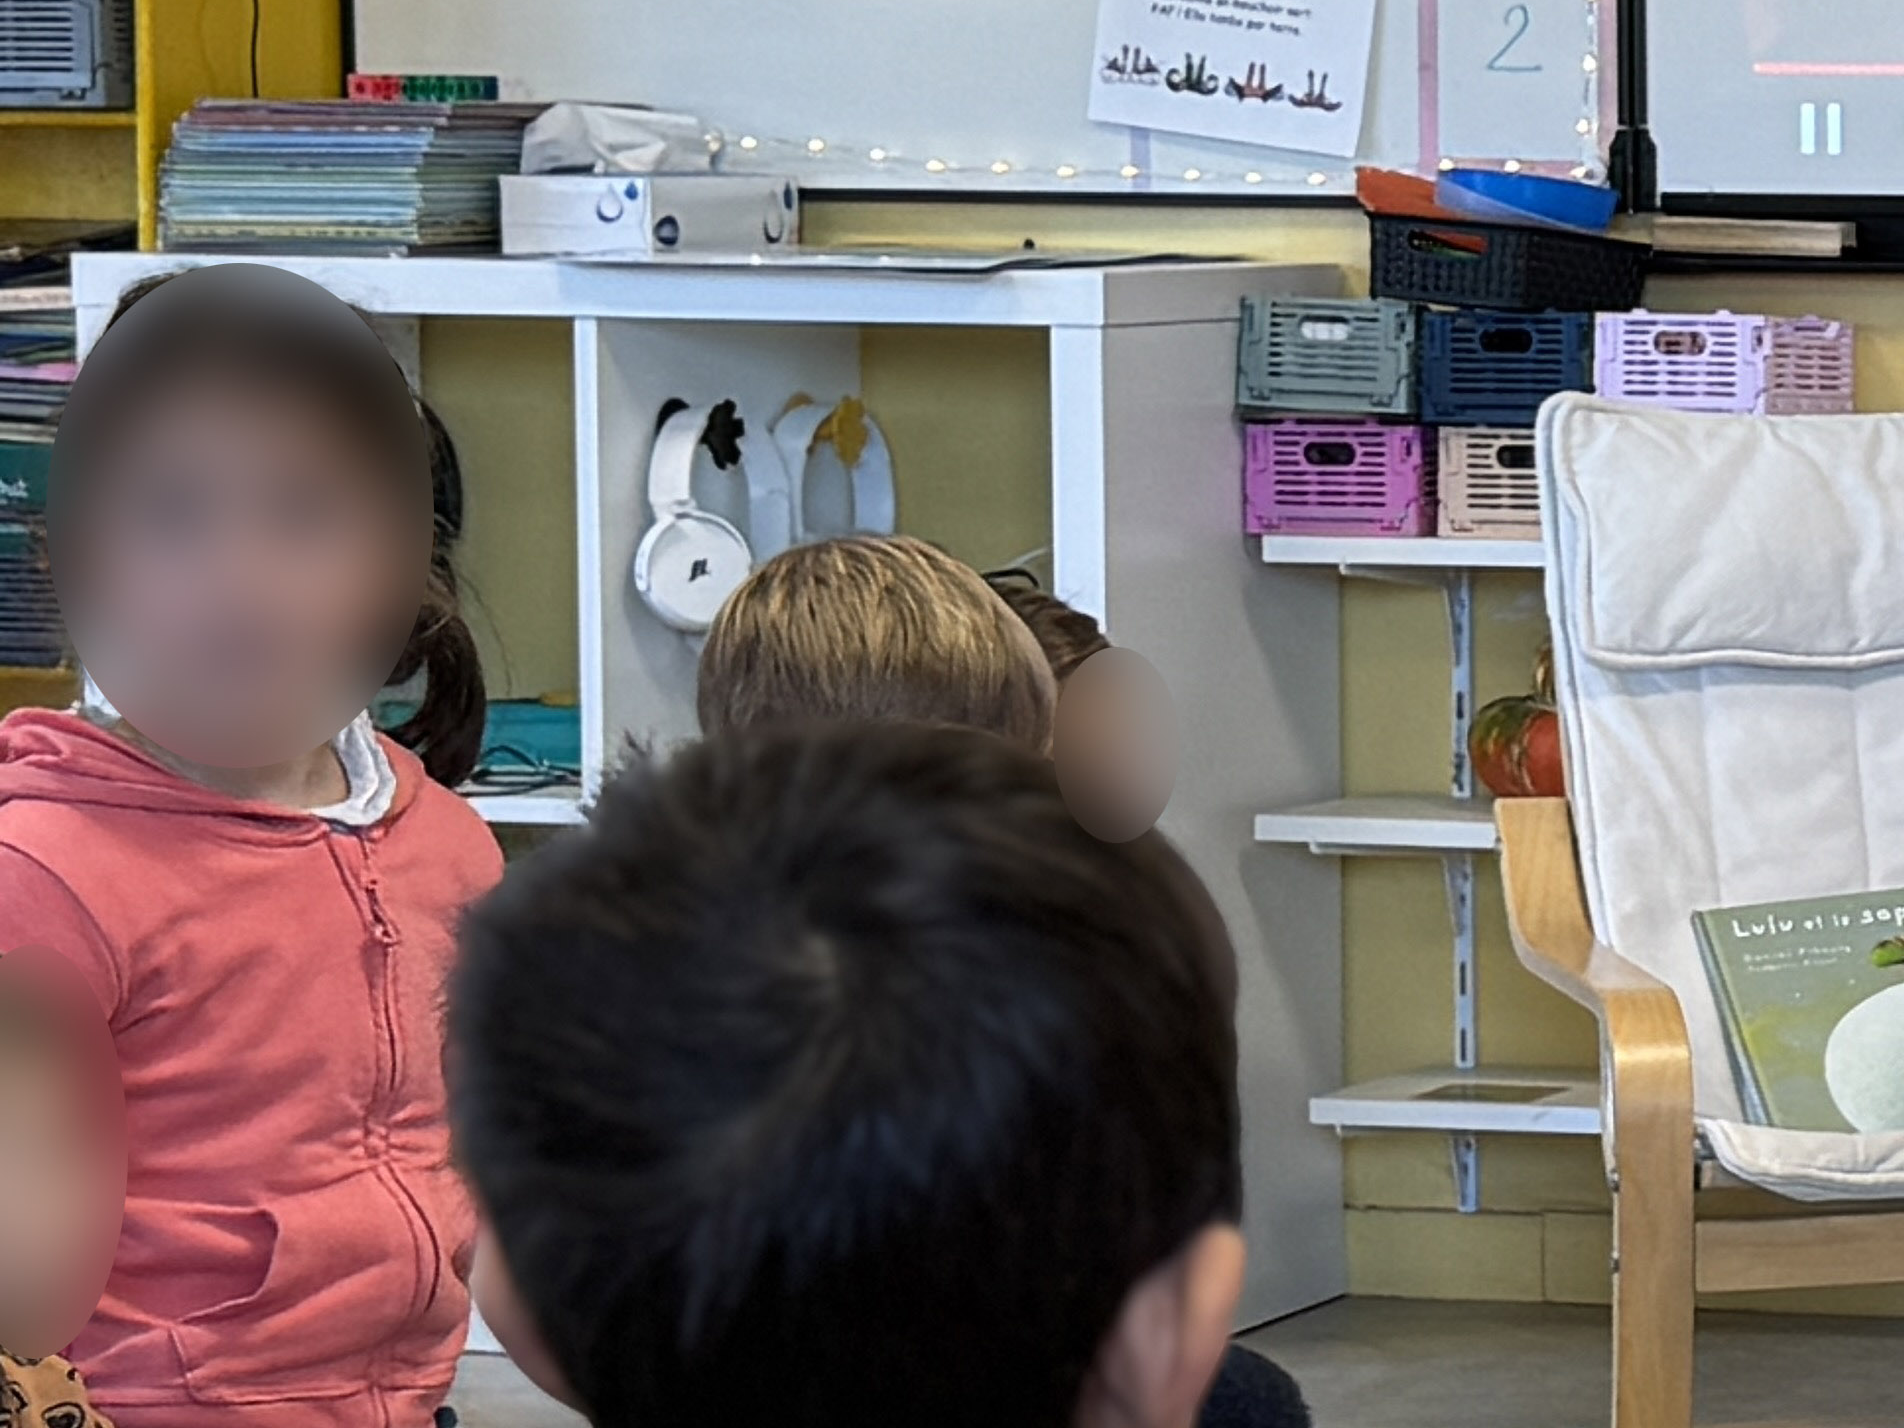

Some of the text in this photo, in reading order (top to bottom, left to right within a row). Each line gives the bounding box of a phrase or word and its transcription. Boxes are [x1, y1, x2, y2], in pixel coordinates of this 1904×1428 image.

[1486, 3, 1543, 71] 2
[1731, 915, 1794, 938] Lulu
[1804, 915, 1823, 931] et
[1832, 914, 1850, 927] le
